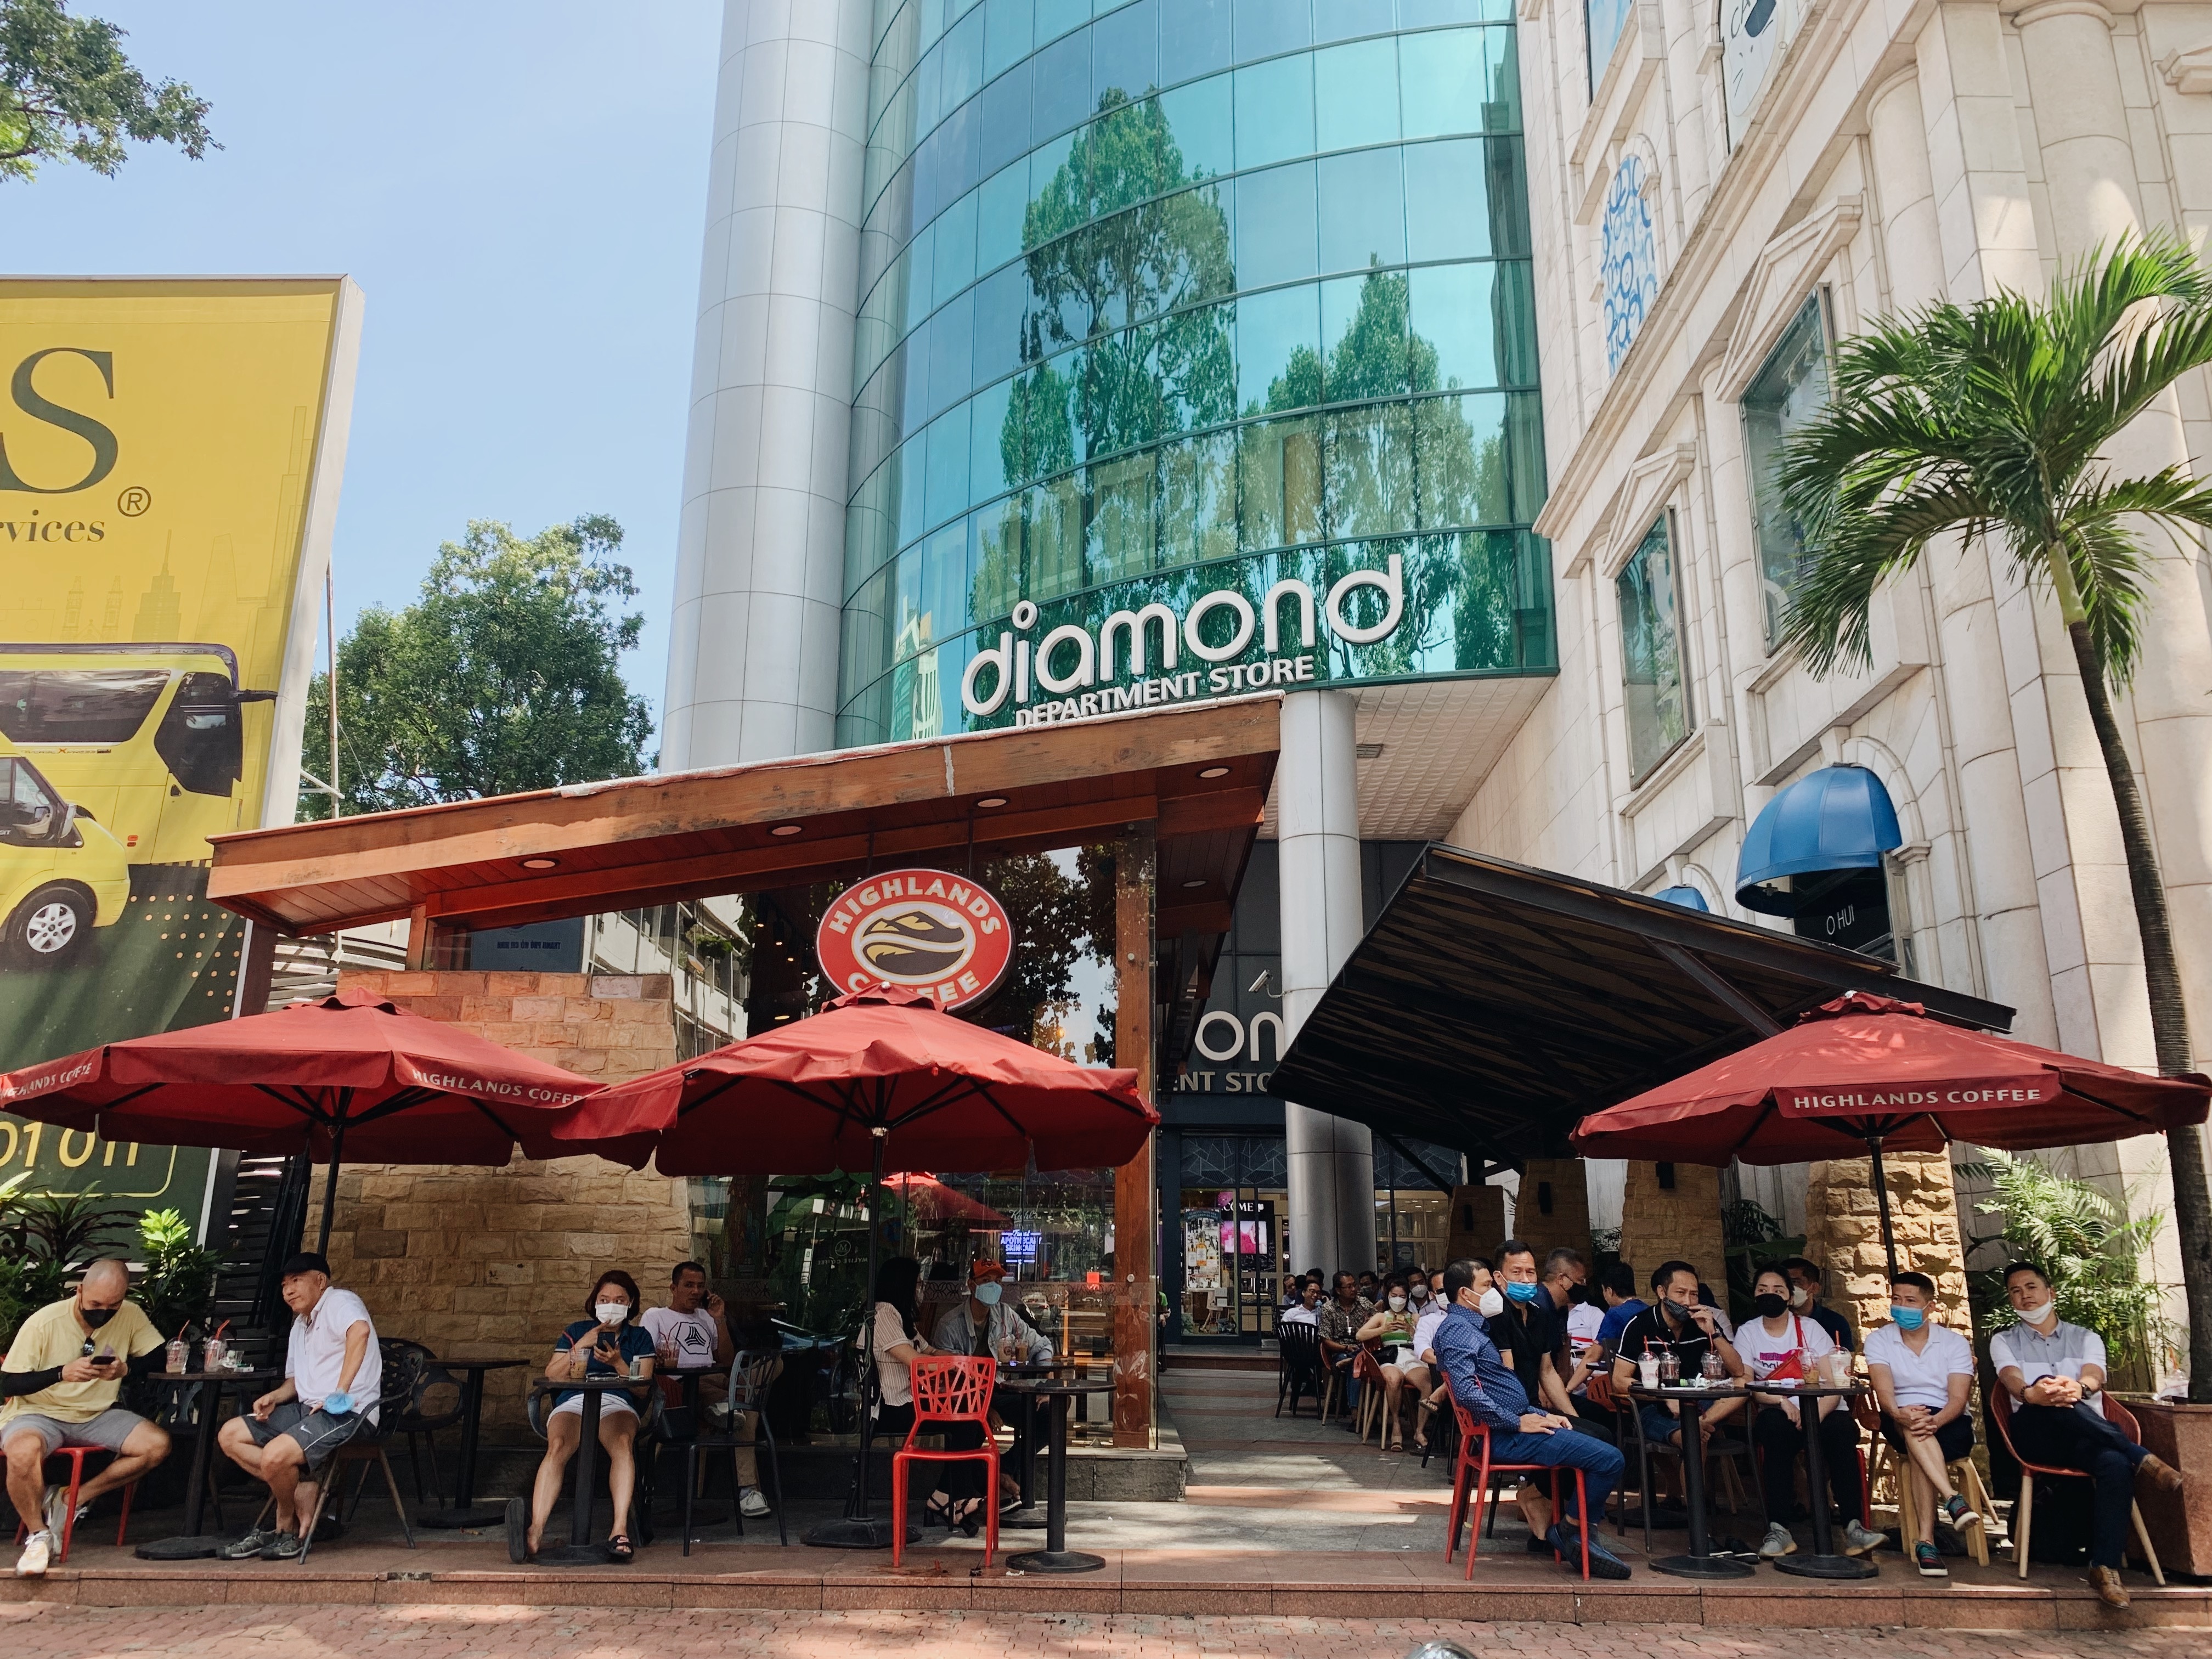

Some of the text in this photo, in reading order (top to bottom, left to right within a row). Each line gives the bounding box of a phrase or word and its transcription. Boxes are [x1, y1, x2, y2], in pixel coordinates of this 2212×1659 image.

[0, 509, 105, 542] vices
[962, 554, 1403, 716] diamond
[1016, 655, 1314, 726] DEPARTMENT STORE
[828, 876, 1001, 935] HIGHLANDS
[1837, 904, 1855, 930] HUI
[848, 970, 980, 1003] CFEE
[412, 1069, 522, 1096] HIGHLANDS
[1795, 1089, 2041, 1108] HIGHLANDS COFFEE
